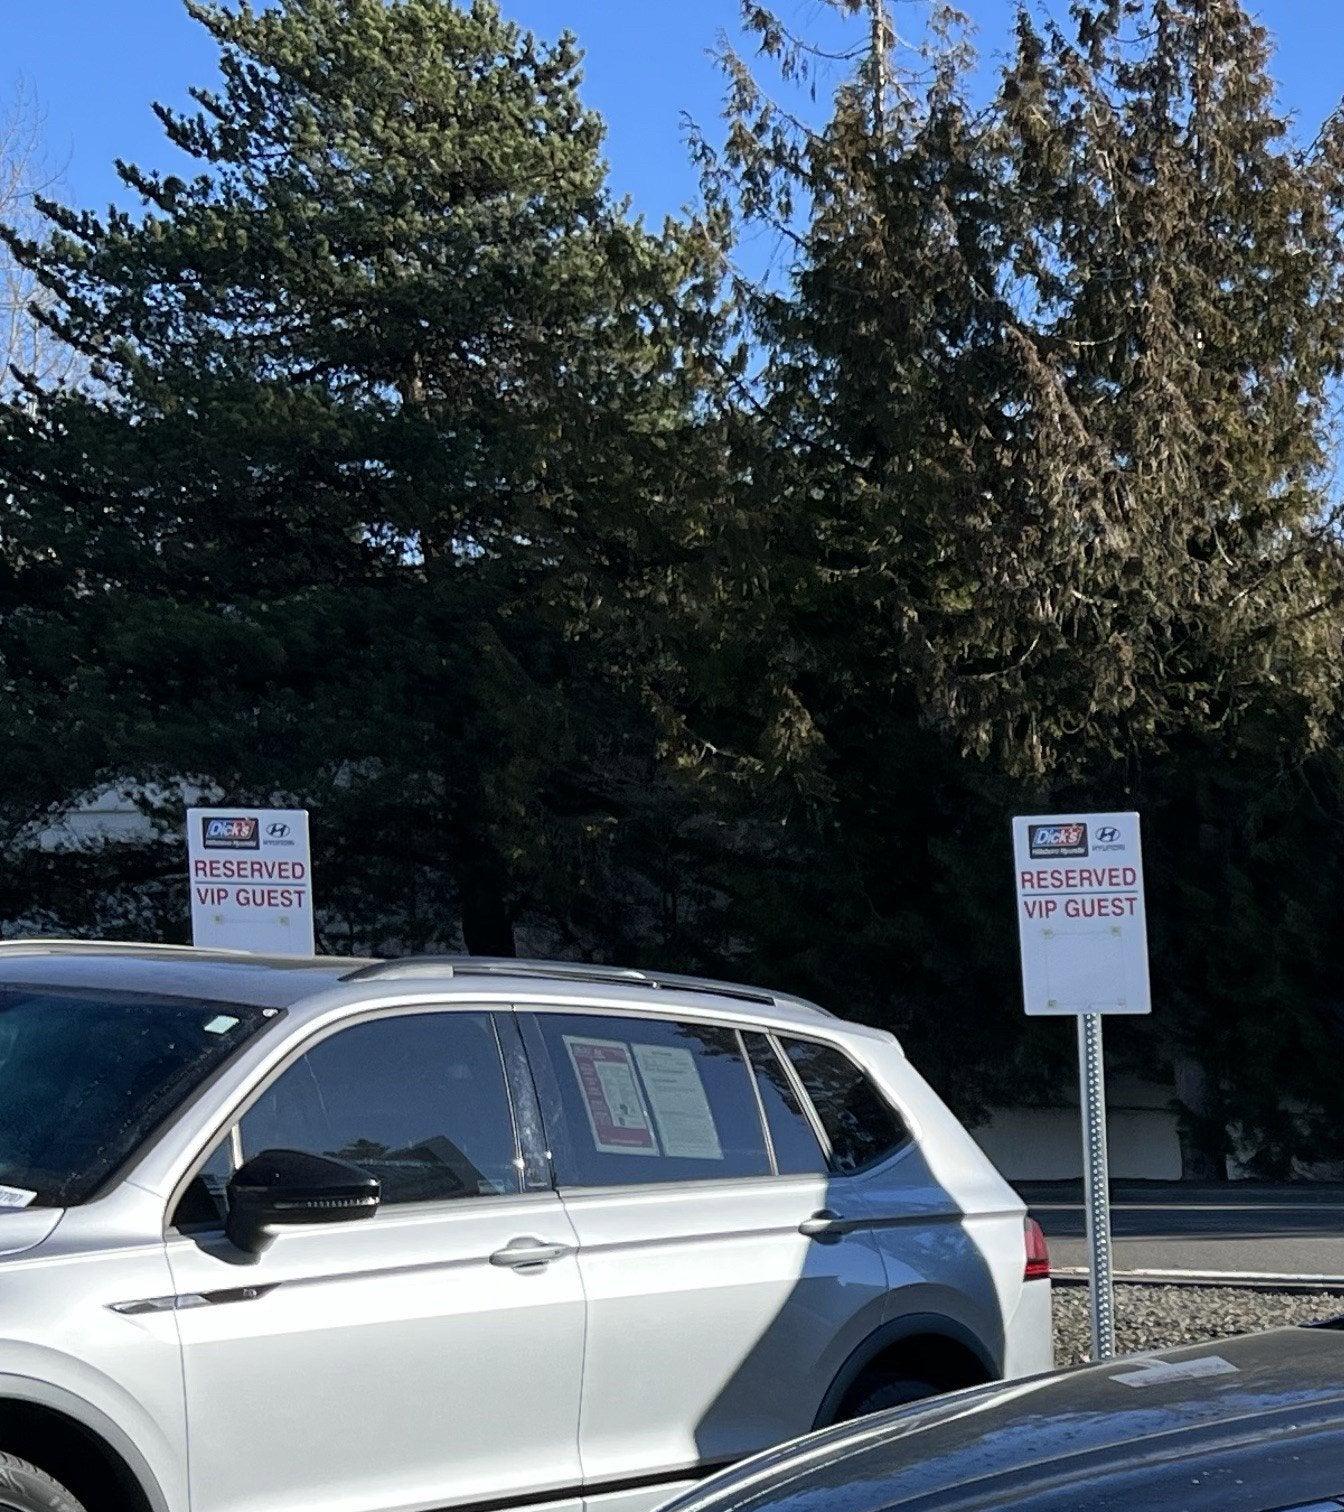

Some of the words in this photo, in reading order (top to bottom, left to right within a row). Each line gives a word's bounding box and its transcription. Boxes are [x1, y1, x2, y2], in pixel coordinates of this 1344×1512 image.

[194, 860, 305, 880] RESERVED
[1021, 868, 1137, 889] RESERVED
[196, 888, 229, 906] VIP
[235, 888, 306, 908] GUEST
[1024, 900, 1058, 919] VIP
[1065, 897, 1138, 918] GUEST
